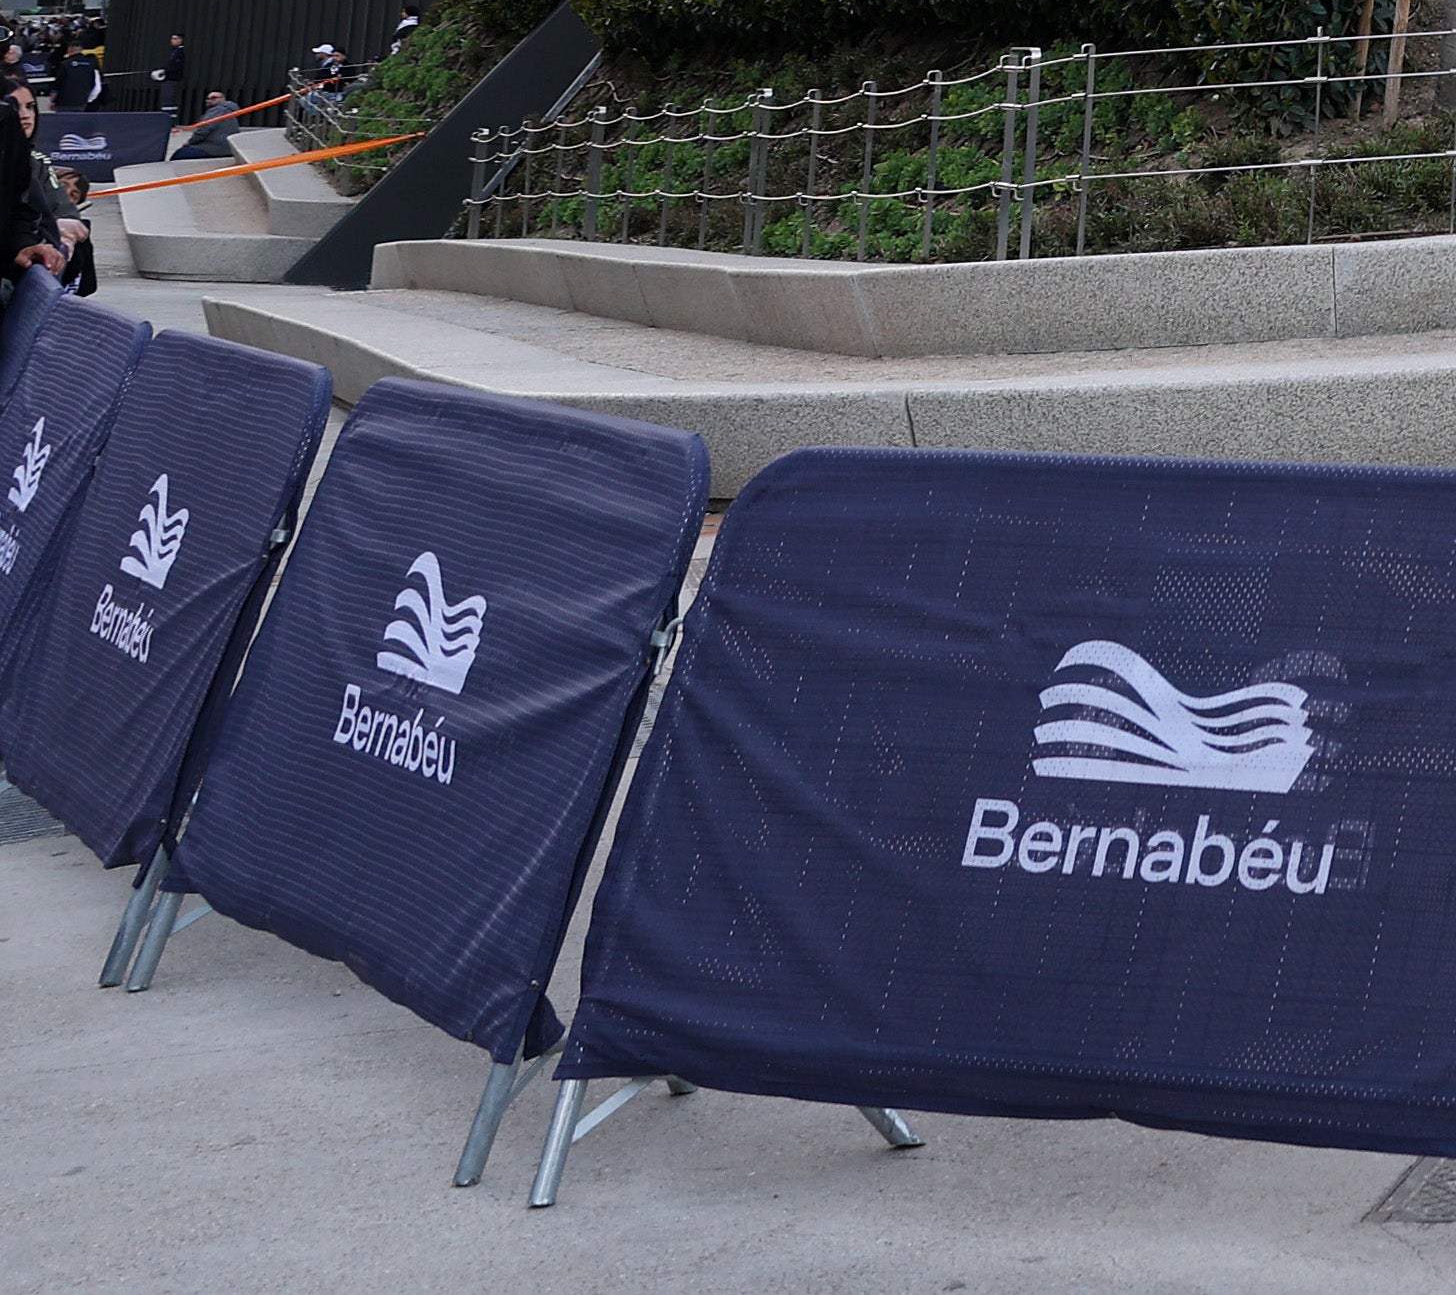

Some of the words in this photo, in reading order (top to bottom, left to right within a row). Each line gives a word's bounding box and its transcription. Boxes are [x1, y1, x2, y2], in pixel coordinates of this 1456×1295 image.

[89, 583, 155, 663] Bernabéu
[332, 683, 457, 785] Bernabéu
[961, 797, 1335, 895] Bernabéu
